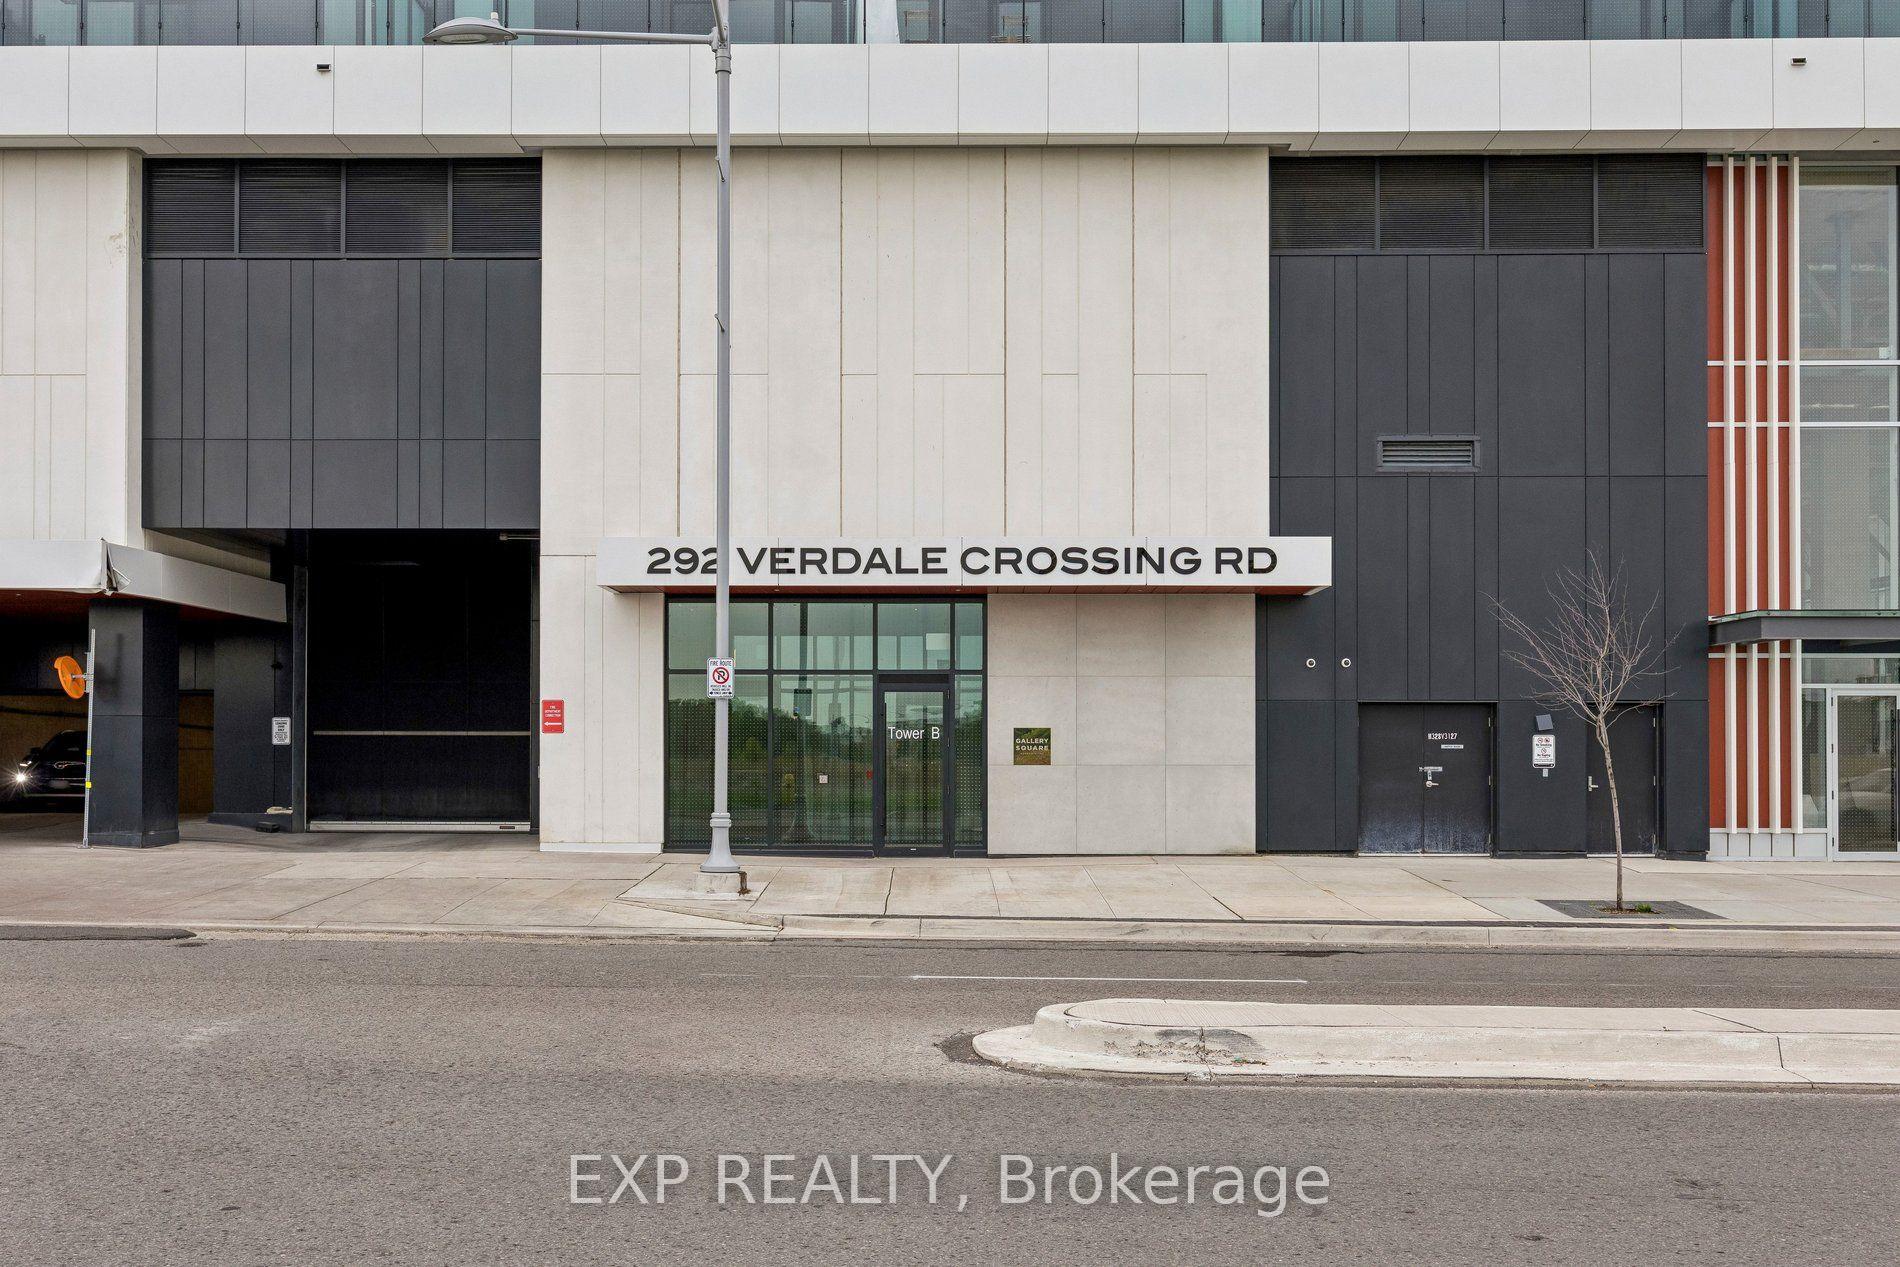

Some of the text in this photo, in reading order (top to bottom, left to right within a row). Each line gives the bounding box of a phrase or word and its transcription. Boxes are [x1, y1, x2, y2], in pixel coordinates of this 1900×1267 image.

[736, 547, 948, 575] VERDALE
[961, 547, 1202, 575] CROSSING
[1215, 547, 1278, 574] RD
[888, 726, 940, 739] Tower B
